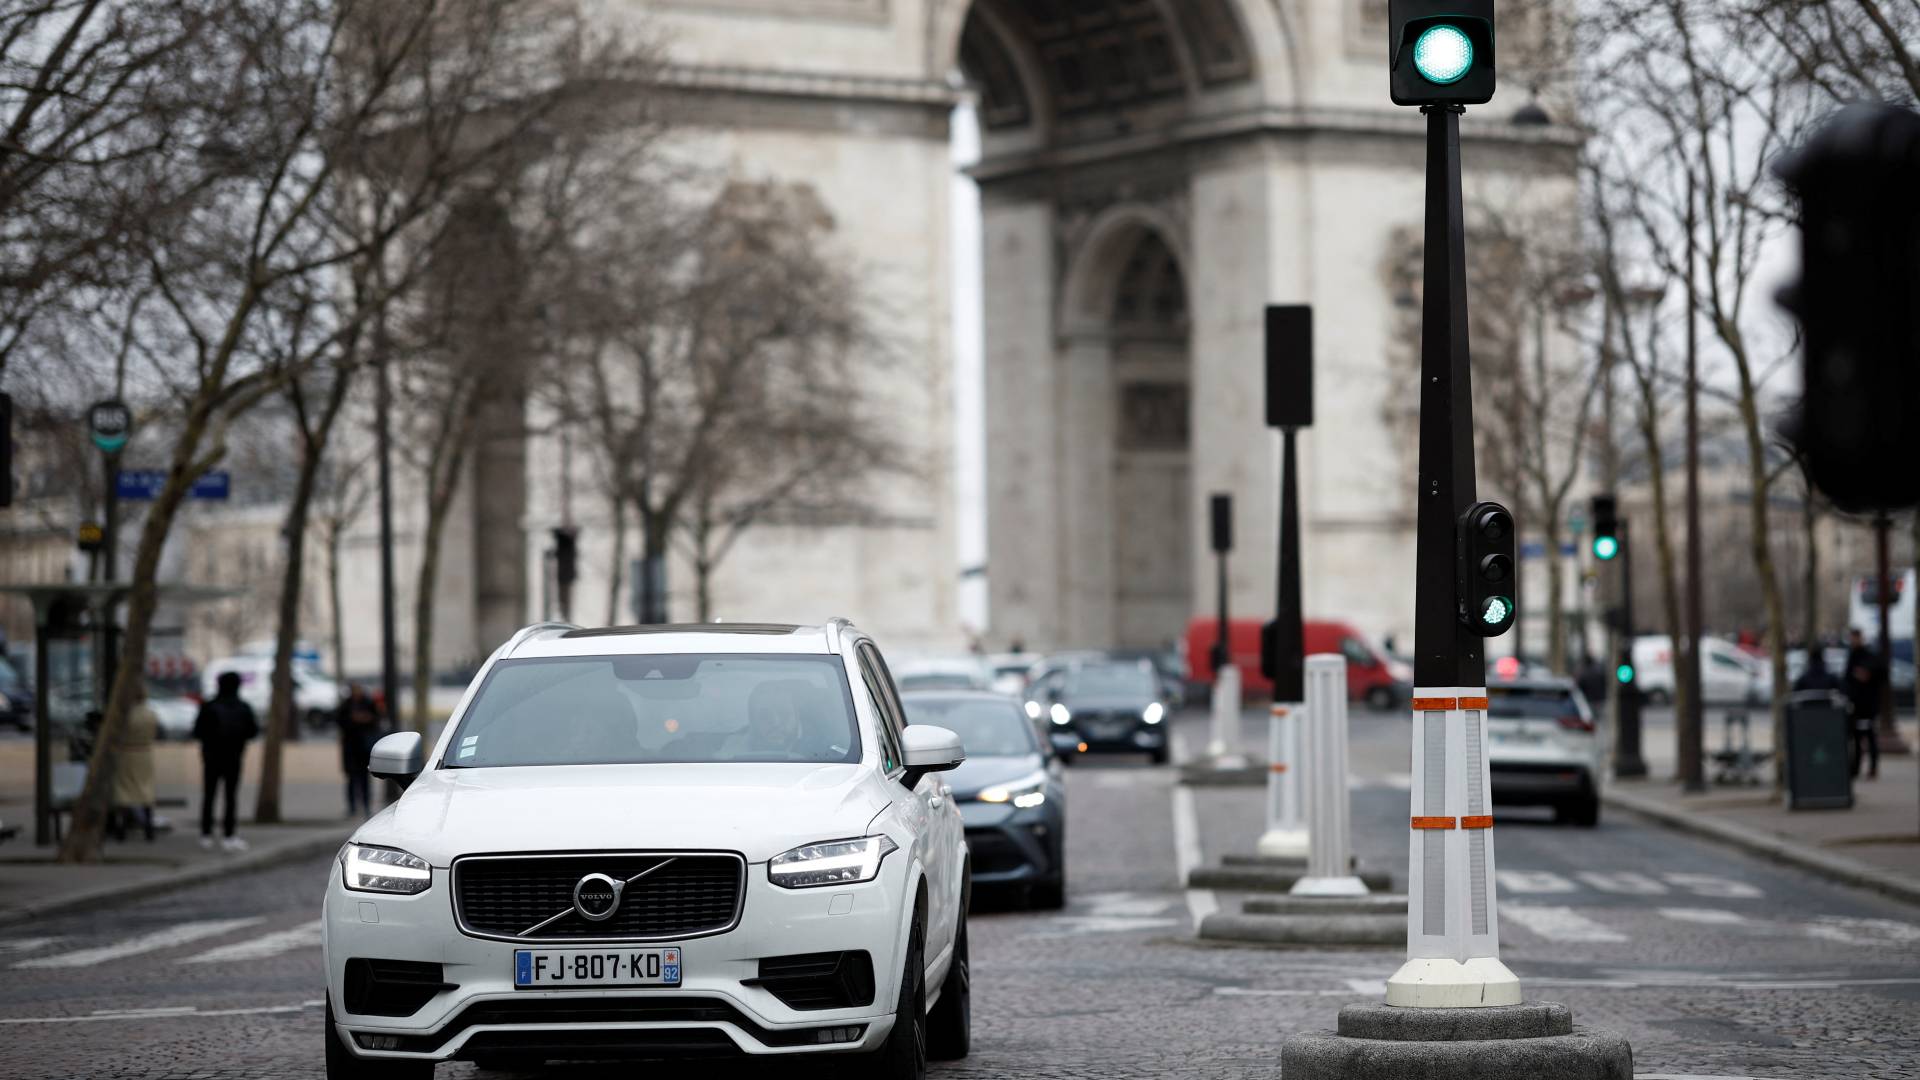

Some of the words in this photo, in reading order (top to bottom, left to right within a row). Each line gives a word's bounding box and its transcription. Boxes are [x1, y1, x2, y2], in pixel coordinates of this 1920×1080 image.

[535, 953, 660, 981] FJ-807-KD
[664, 967, 678, 980] 92
[521, 971, 527, 980] F
